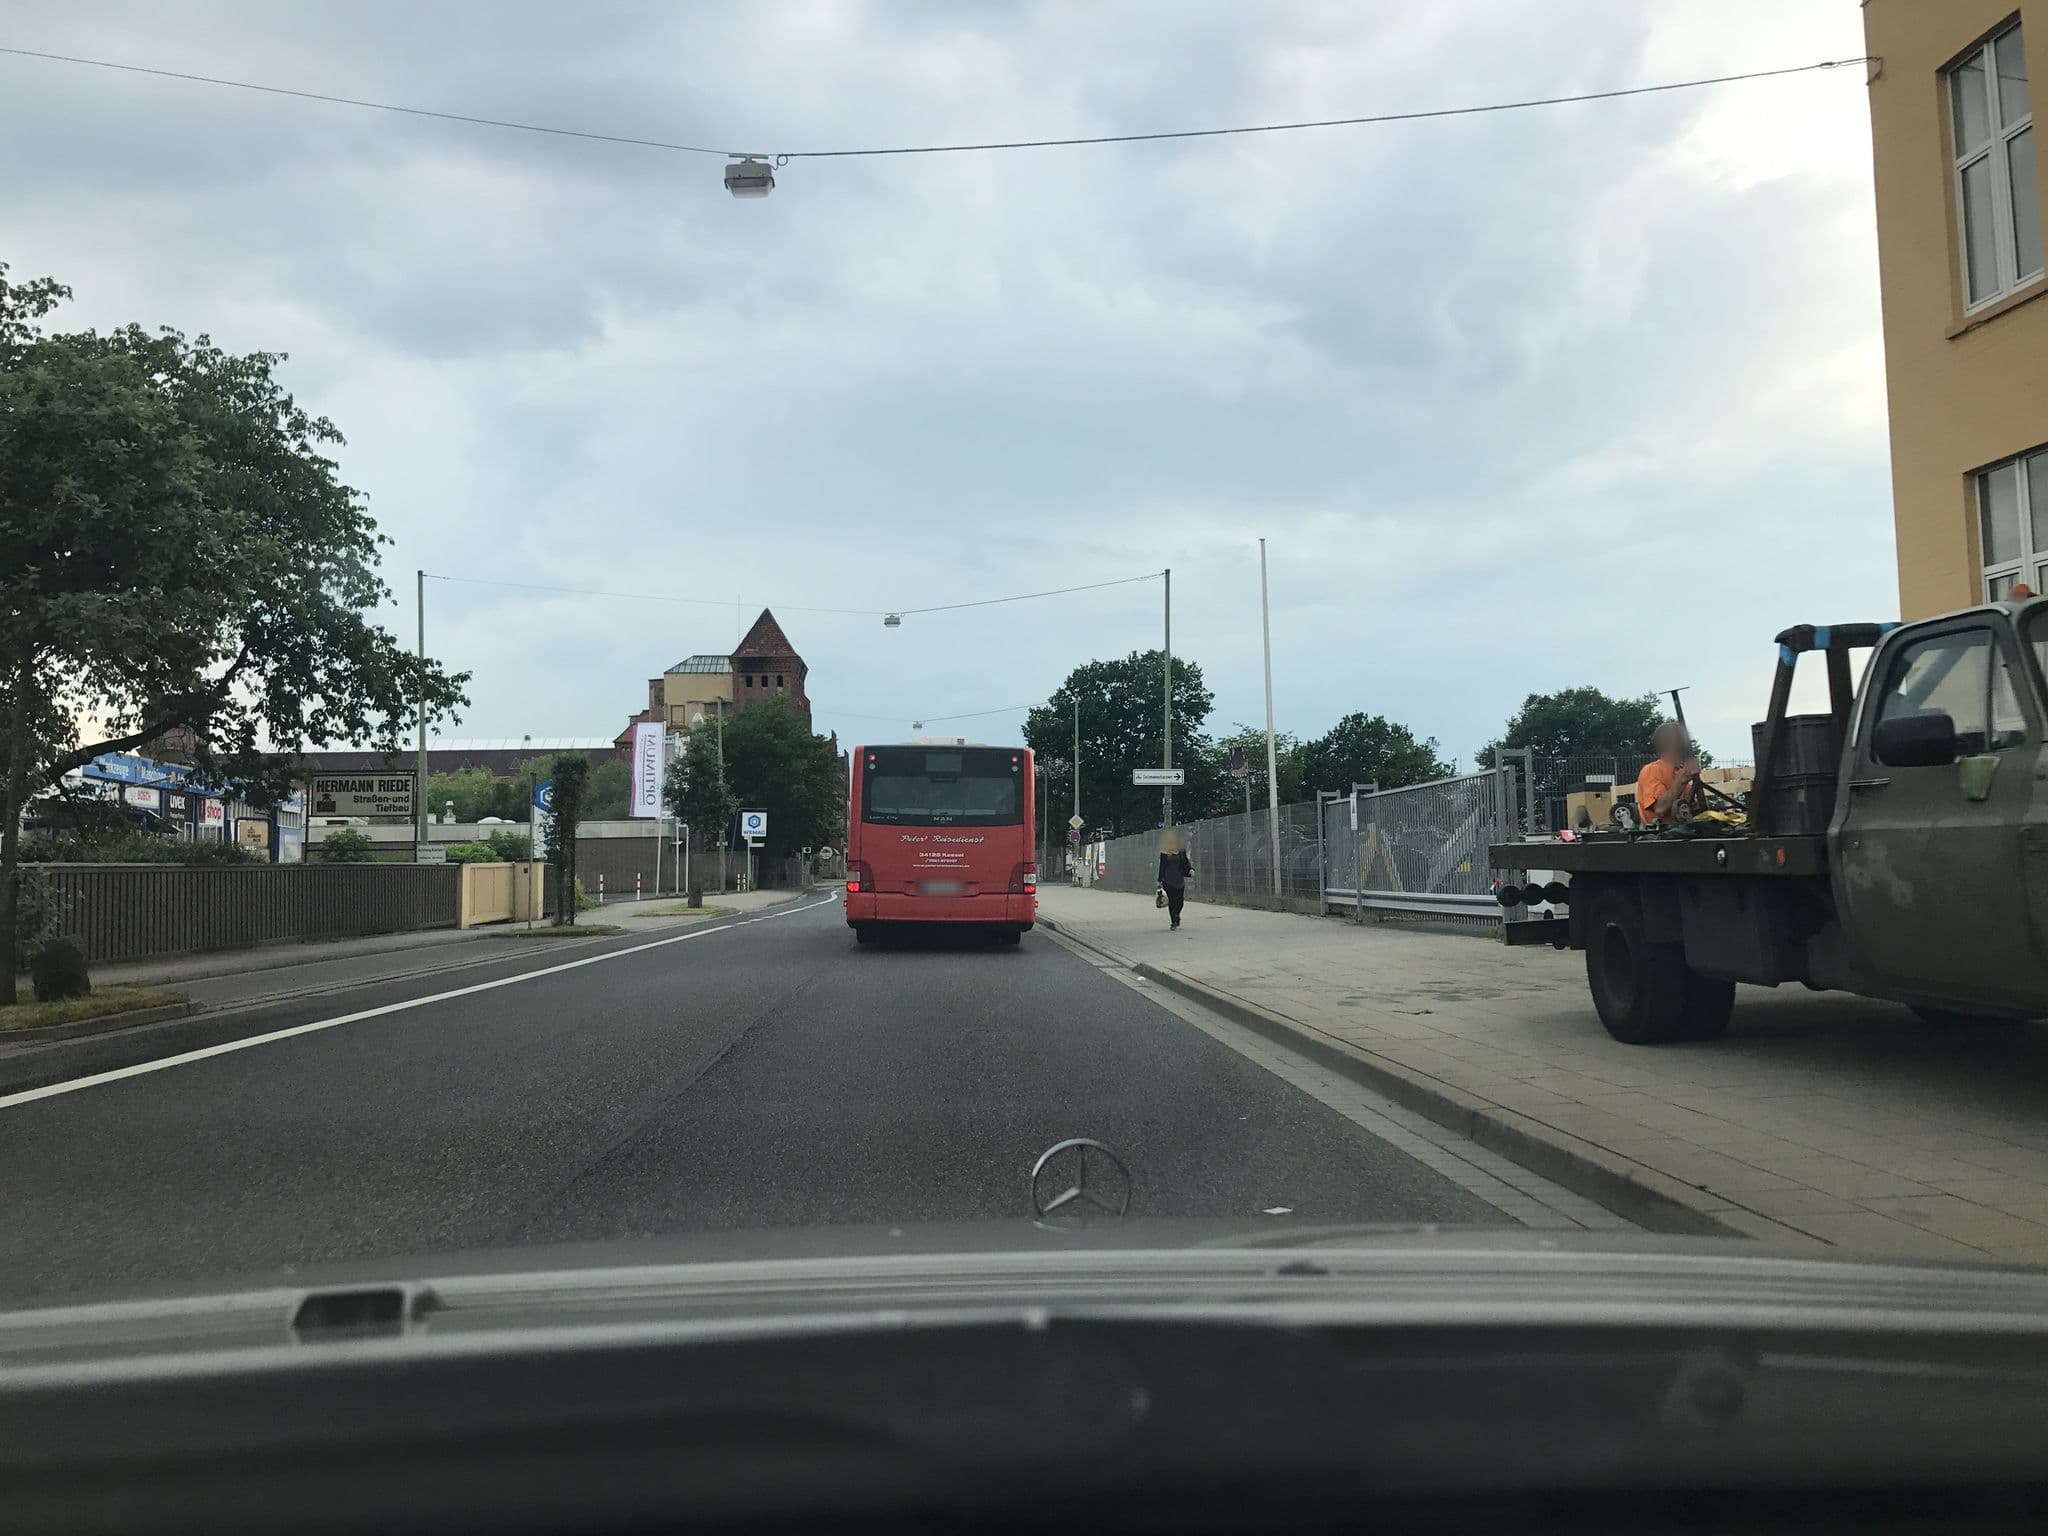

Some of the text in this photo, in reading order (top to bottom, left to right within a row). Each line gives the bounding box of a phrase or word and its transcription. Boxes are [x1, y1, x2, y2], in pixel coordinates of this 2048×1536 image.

[316, 779, 410, 792] HERMANN RIEDE
[207, 805, 221, 821] shop
[375, 804, 409, 812] Tiefbau
